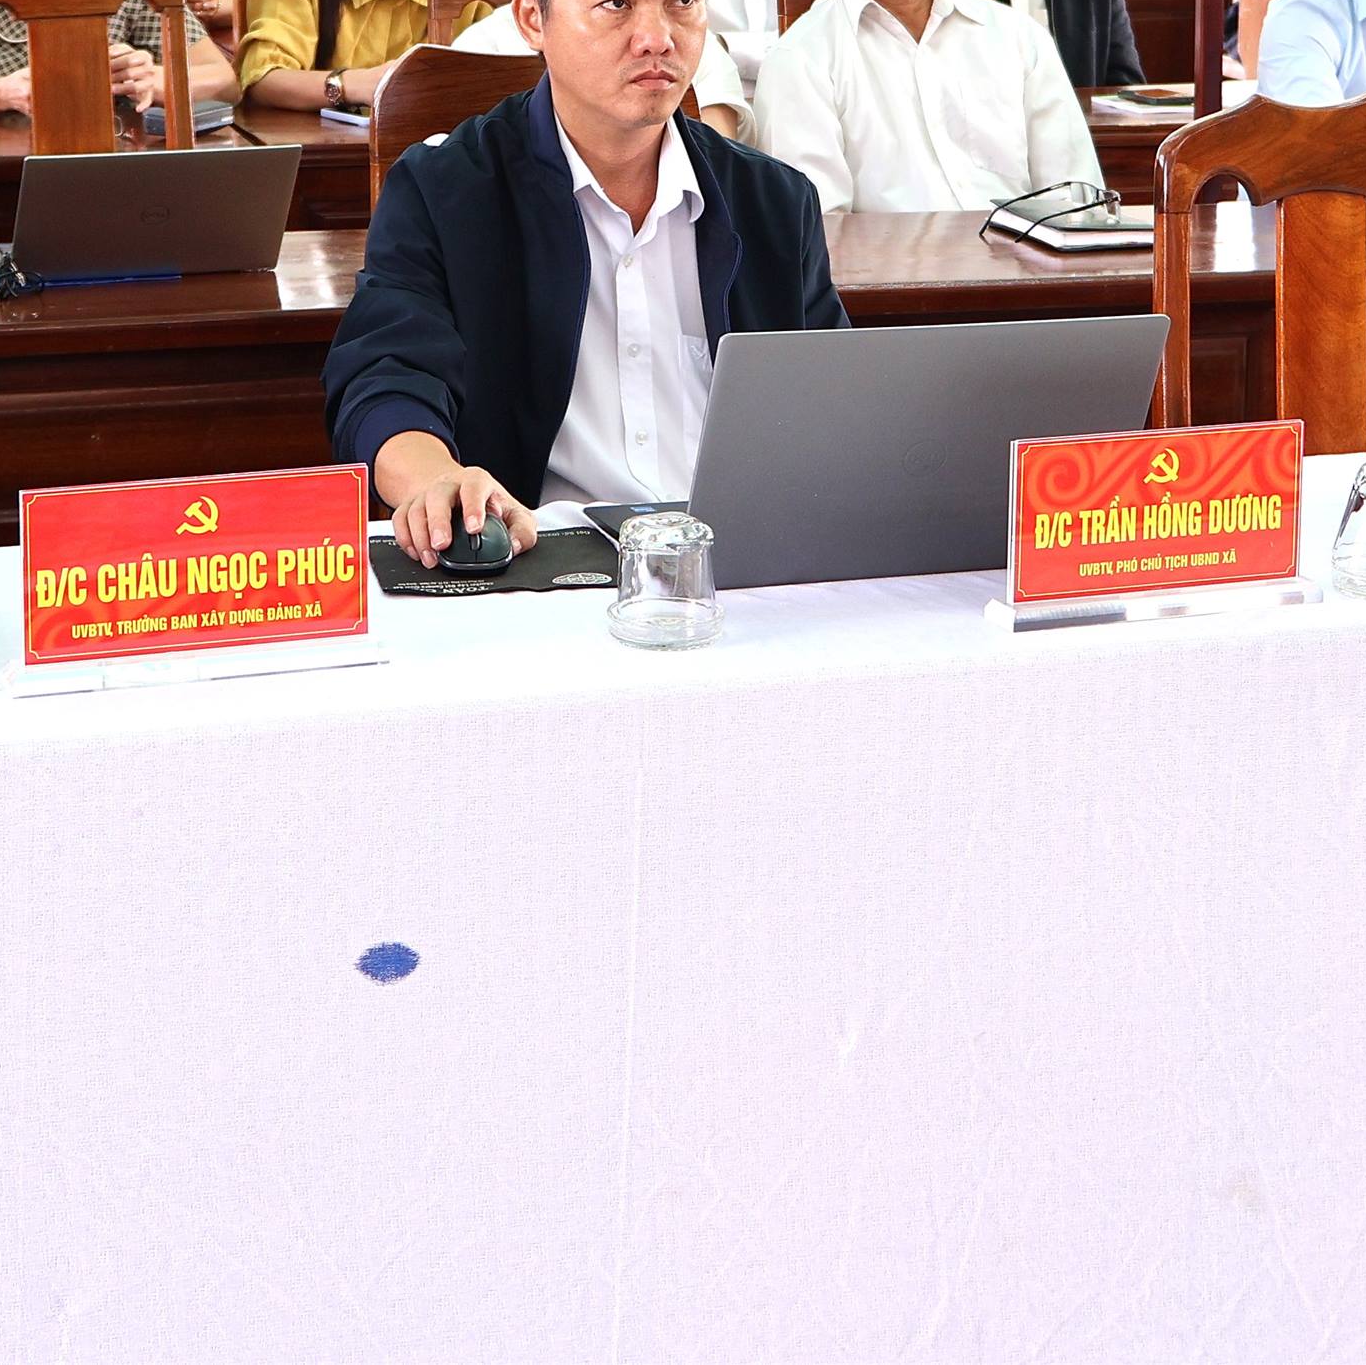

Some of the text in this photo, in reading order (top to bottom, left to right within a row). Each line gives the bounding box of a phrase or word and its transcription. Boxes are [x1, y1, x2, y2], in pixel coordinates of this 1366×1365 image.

[1035, 491, 1282, 550] Đ/C TRẦN HỒNG DƯƠNG
[35, 538, 355, 608] Đ/C CHÂU NGỌC PHÚC
[1116, 556, 1138, 574] PHÓ
[1140, 553, 1162, 572] CHỦ
[1164, 555, 1188, 572] TỊCH
[1190, 552, 1219, 567] UBND
[1222, 548, 1237, 564] XÃ
[71, 601, 322, 639] UVBTV, TRƯỞNG BAN XÂY DỰNG ĐẢNG XÃ
